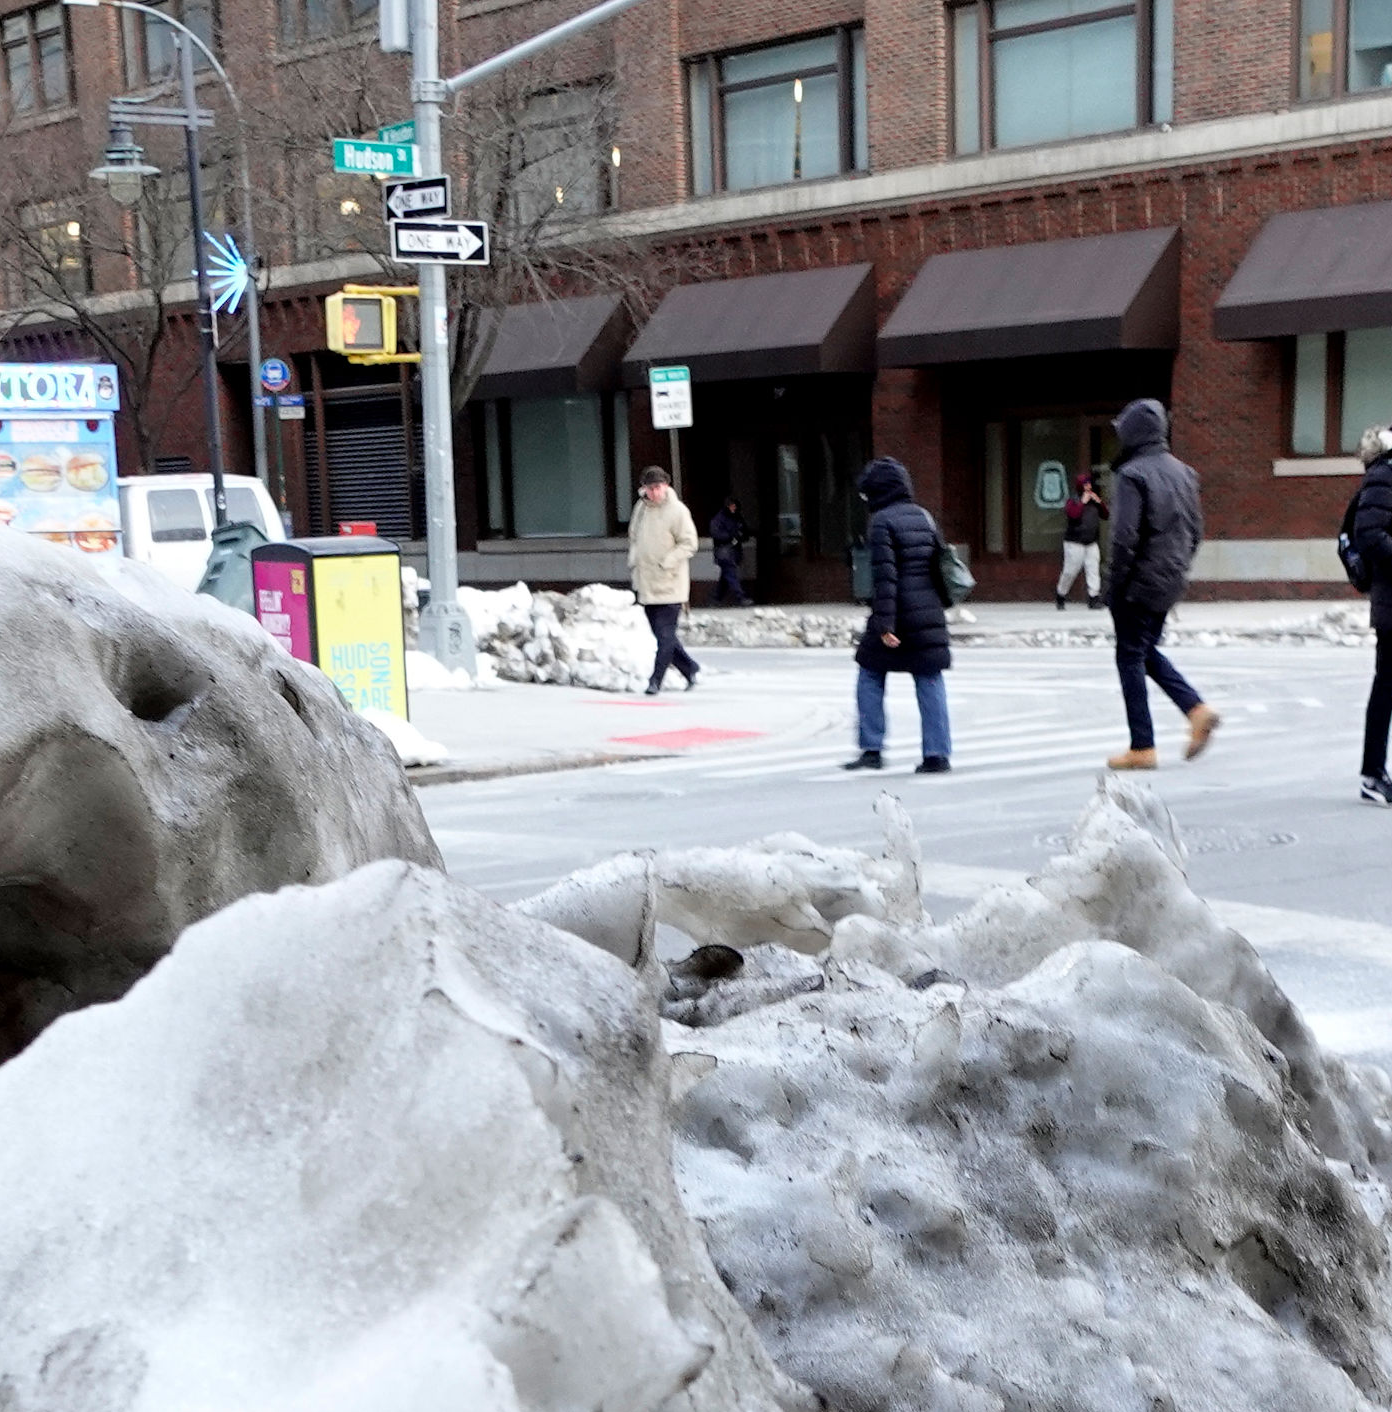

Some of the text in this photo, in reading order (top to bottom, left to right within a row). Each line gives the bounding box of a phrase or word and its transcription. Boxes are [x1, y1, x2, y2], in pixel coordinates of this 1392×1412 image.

[343, 144, 394, 171] Hudson
[395, 190, 440, 210] ONE WAY
[407, 234, 471, 250] ONE WAY
